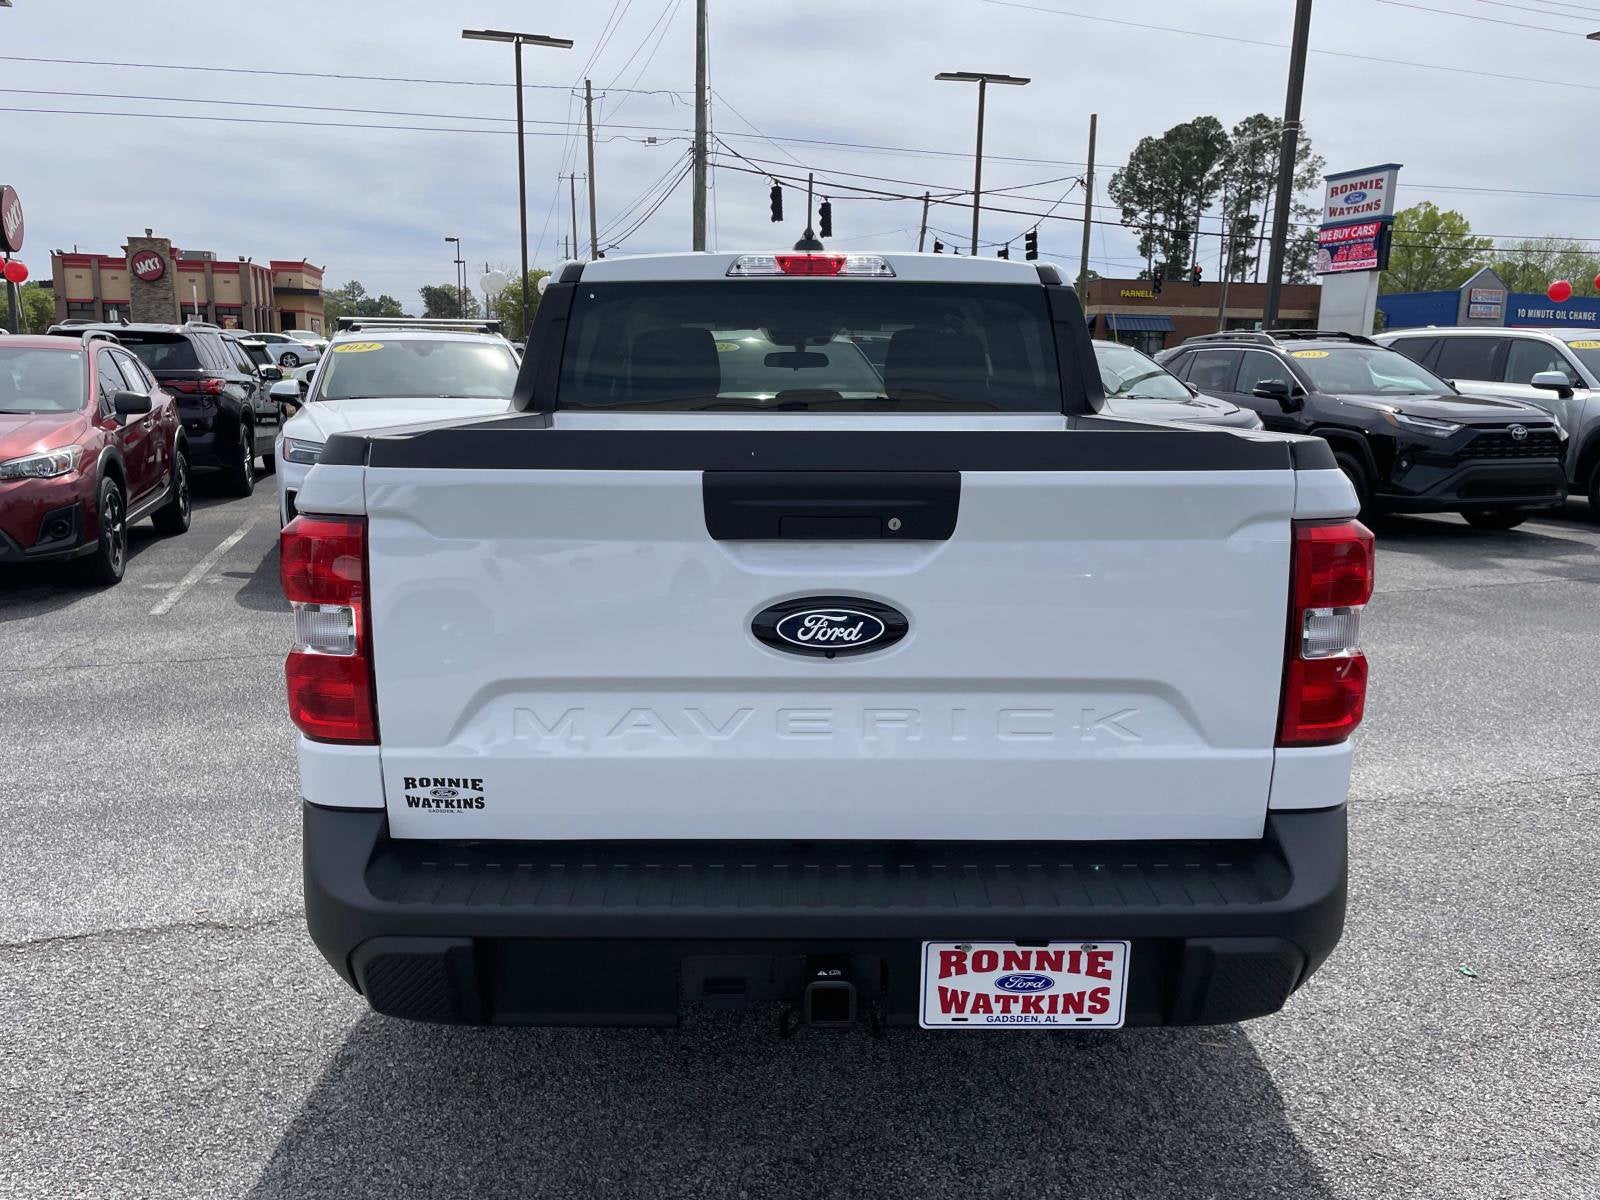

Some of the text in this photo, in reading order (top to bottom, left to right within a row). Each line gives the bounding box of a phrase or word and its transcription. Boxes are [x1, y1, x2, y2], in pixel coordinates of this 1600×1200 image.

[1330, 177, 1384, 198] RONNIE
[1328, 198, 1382, 217] WATKINS
[1320, 224, 1376, 242] WE BUY CARS!
[1120, 289, 1154, 298] PARNELL
[1517, 308, 1597, 321] 10 MINUTE OIL CHANGE
[339, 343, 375, 352] 2024
[797, 614, 864, 641] Ford
[512, 706, 1144, 743] MAVERICK
[403, 777, 484, 792] RONNIE
[405, 795, 485, 810] WATKINS
[938, 949, 1114, 980] RONNIE
[1004, 976, 1045, 989] Ford
[937, 985, 1111, 1015] WATKINS
[986, 1015, 1058, 1024] GADSDEN, AL
